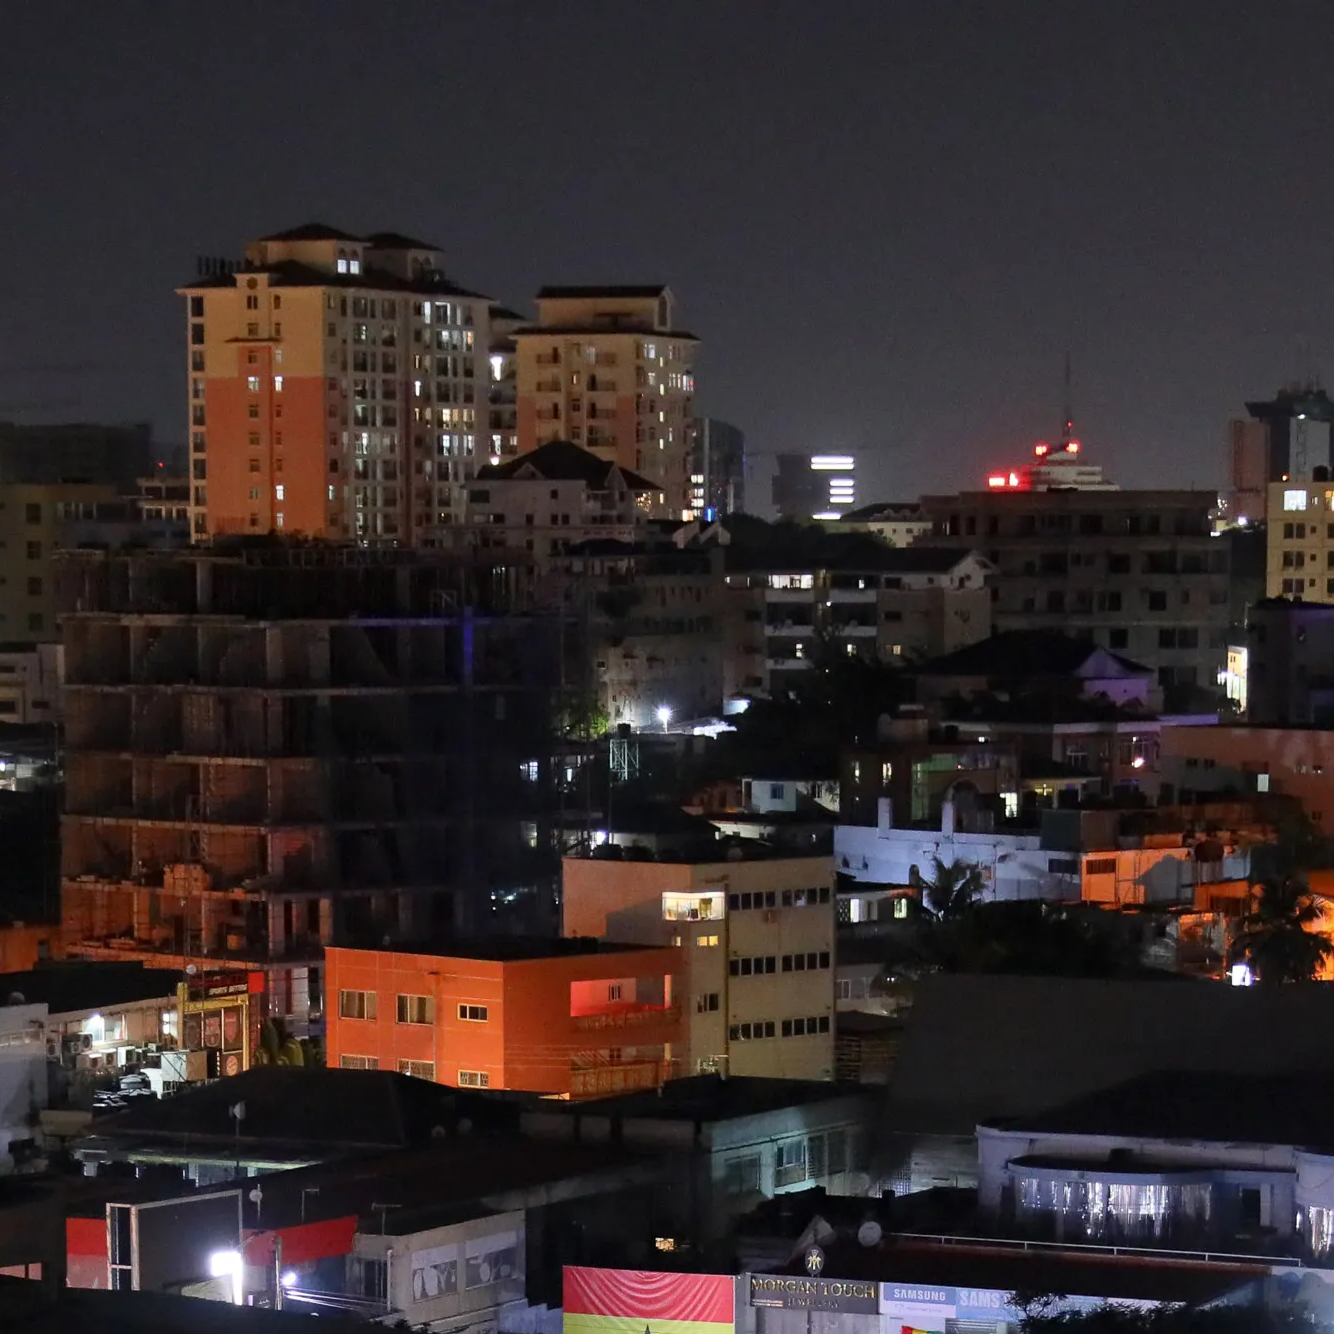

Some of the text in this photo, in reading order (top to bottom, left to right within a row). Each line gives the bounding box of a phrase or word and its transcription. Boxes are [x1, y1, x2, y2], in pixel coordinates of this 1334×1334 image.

[751, 1279, 877, 1299] MORGAN TOUCH
[893, 1288, 946, 1301] SAMSUNG
